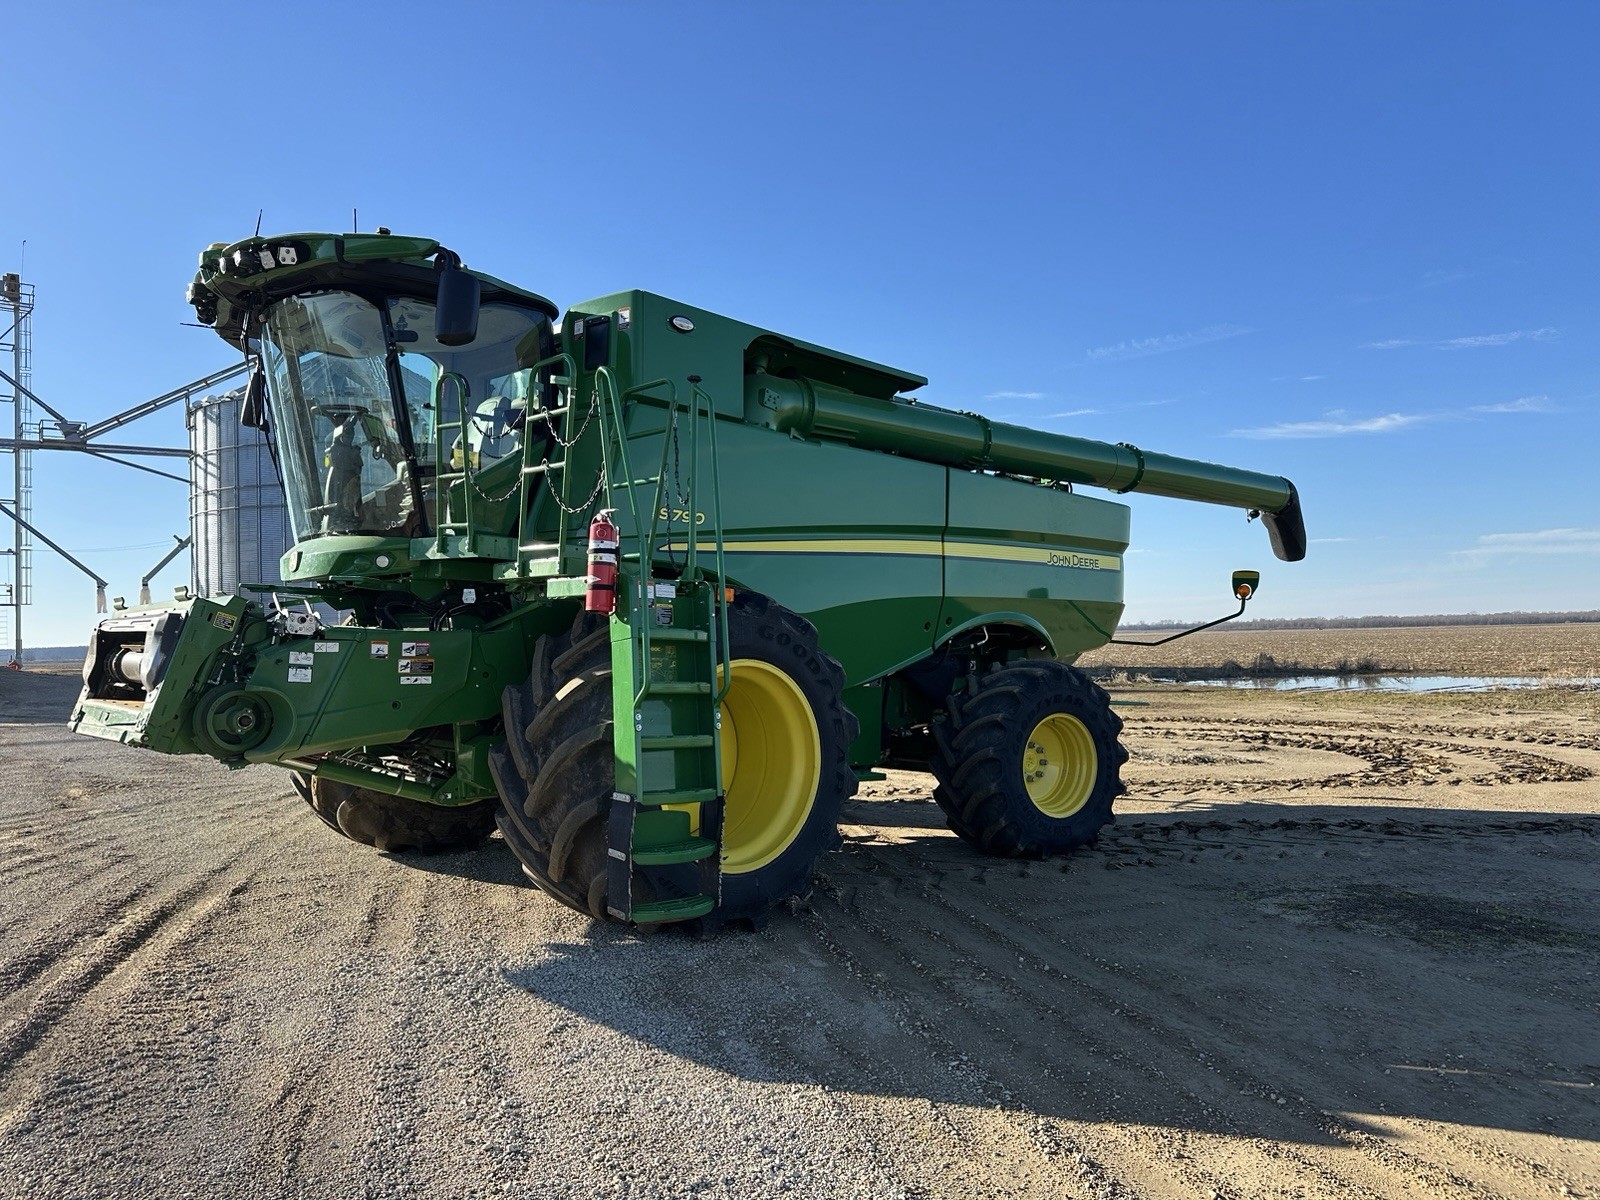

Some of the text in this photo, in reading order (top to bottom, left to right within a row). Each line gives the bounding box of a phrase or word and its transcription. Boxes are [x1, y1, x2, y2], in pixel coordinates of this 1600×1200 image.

[659, 508, 705, 525] S790
[1047, 552, 1100, 568] JOHN DEERE
